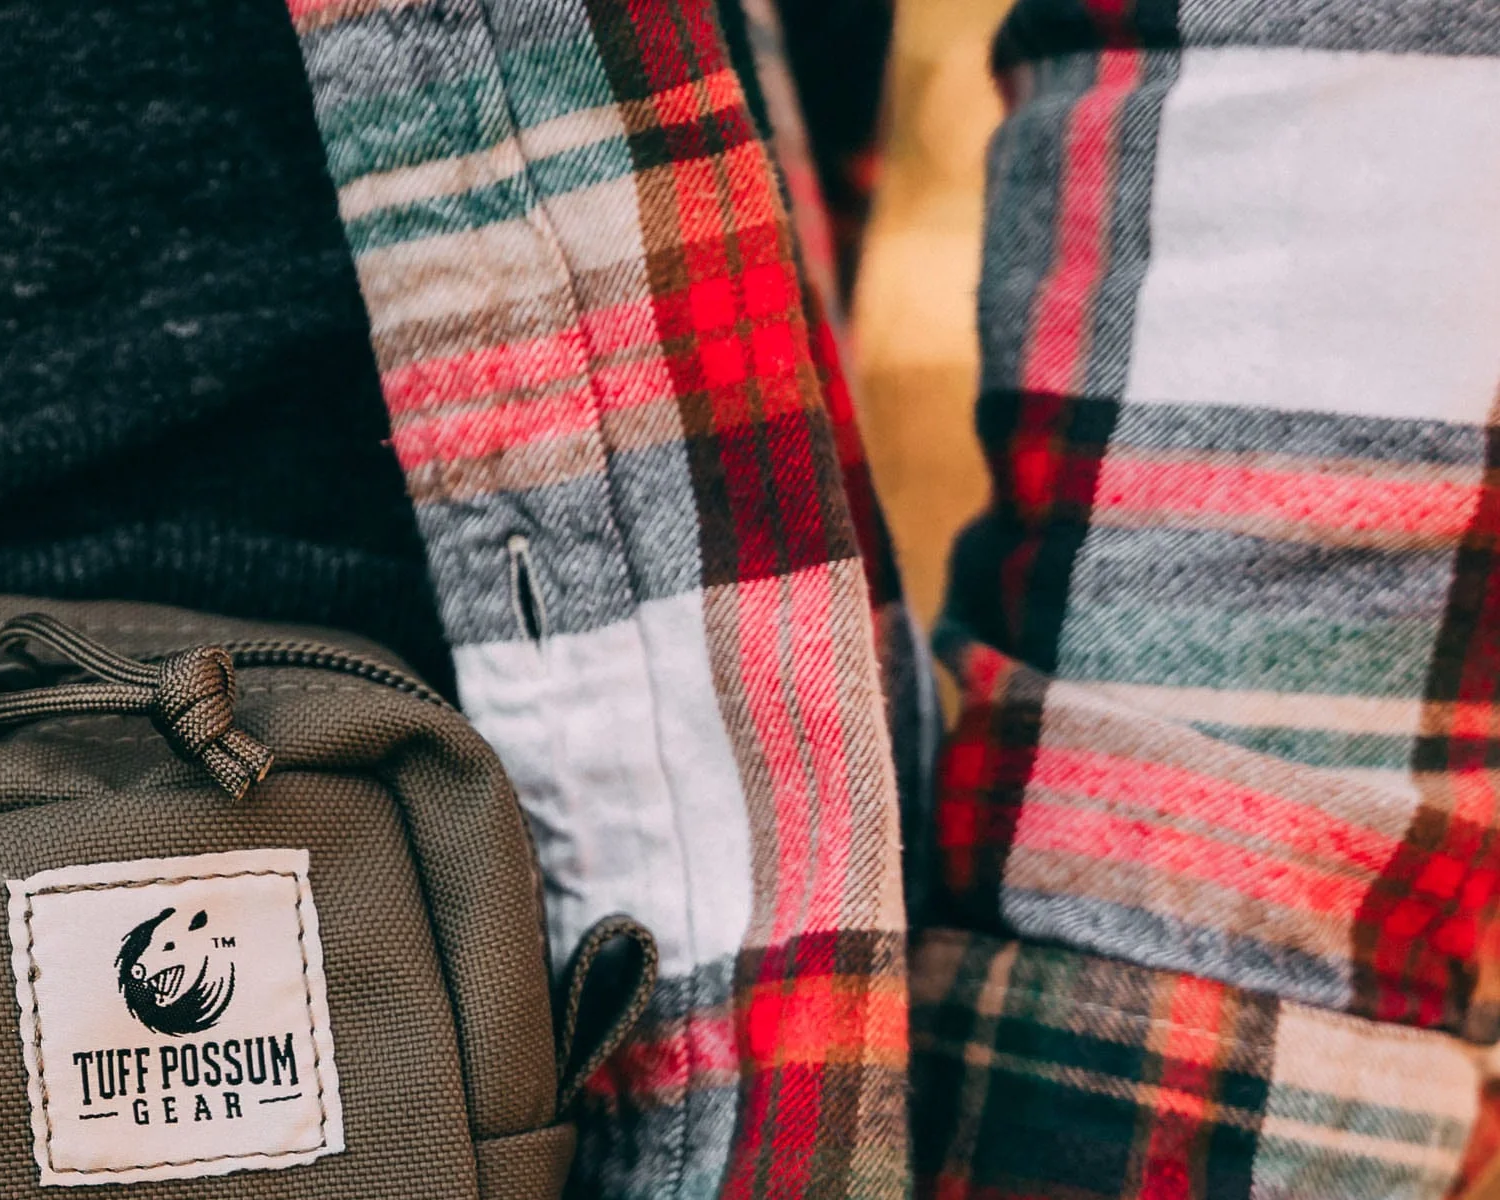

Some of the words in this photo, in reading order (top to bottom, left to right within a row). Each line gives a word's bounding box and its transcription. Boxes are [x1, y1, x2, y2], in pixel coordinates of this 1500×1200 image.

[73, 1046, 151, 1106] TUFF
[160, 1032, 299, 1090] POSSUM
[132, 1092, 243, 1125] GEAR
